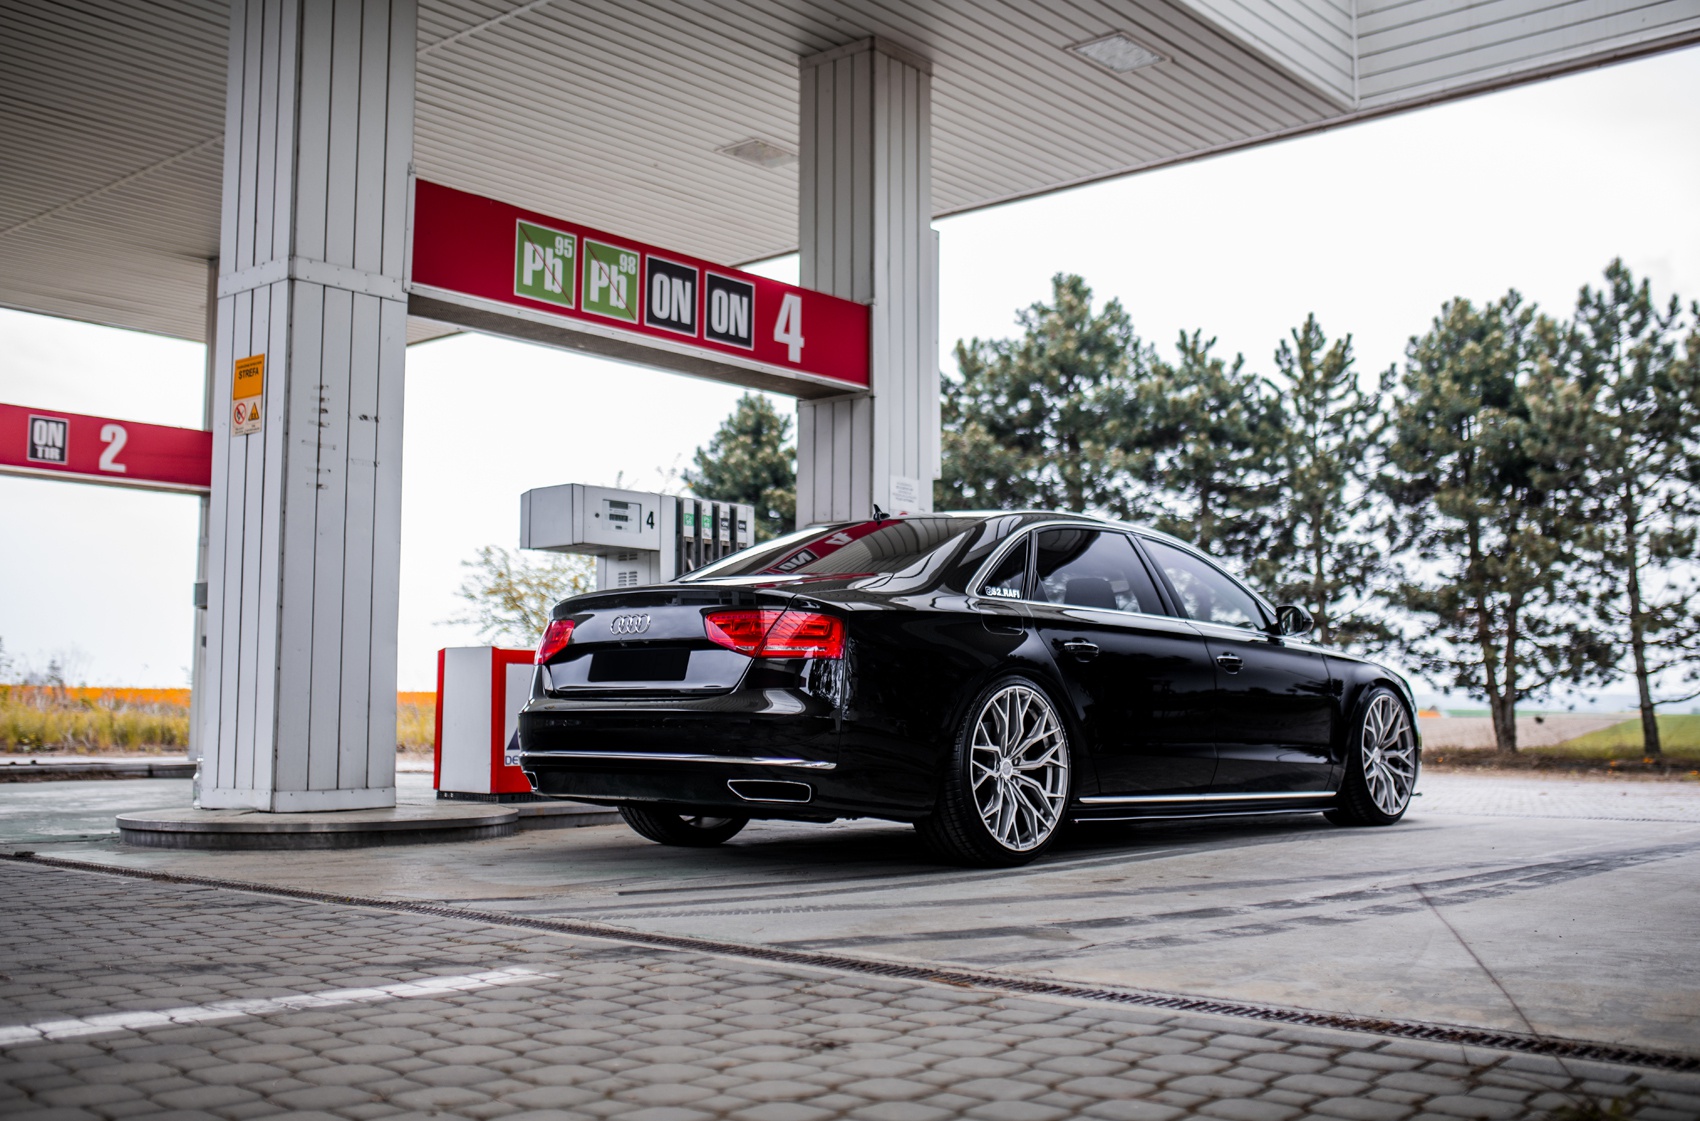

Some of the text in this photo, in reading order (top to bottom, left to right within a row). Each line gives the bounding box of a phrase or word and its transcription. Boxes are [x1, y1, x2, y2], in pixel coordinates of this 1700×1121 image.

[523, 236, 573, 294] Pb 95
[590, 253, 637, 309] Pb 98
[651, 273, 692, 325] ON
[710, 288, 749, 339] ON
[774, 293, 805, 363] 4
[238, 366, 260, 380] STREFA
[33, 420, 64, 448] ON
[35, 446, 60, 460] TIR
[99, 424, 127, 472] 2
[646, 511, 655, 530] 4
